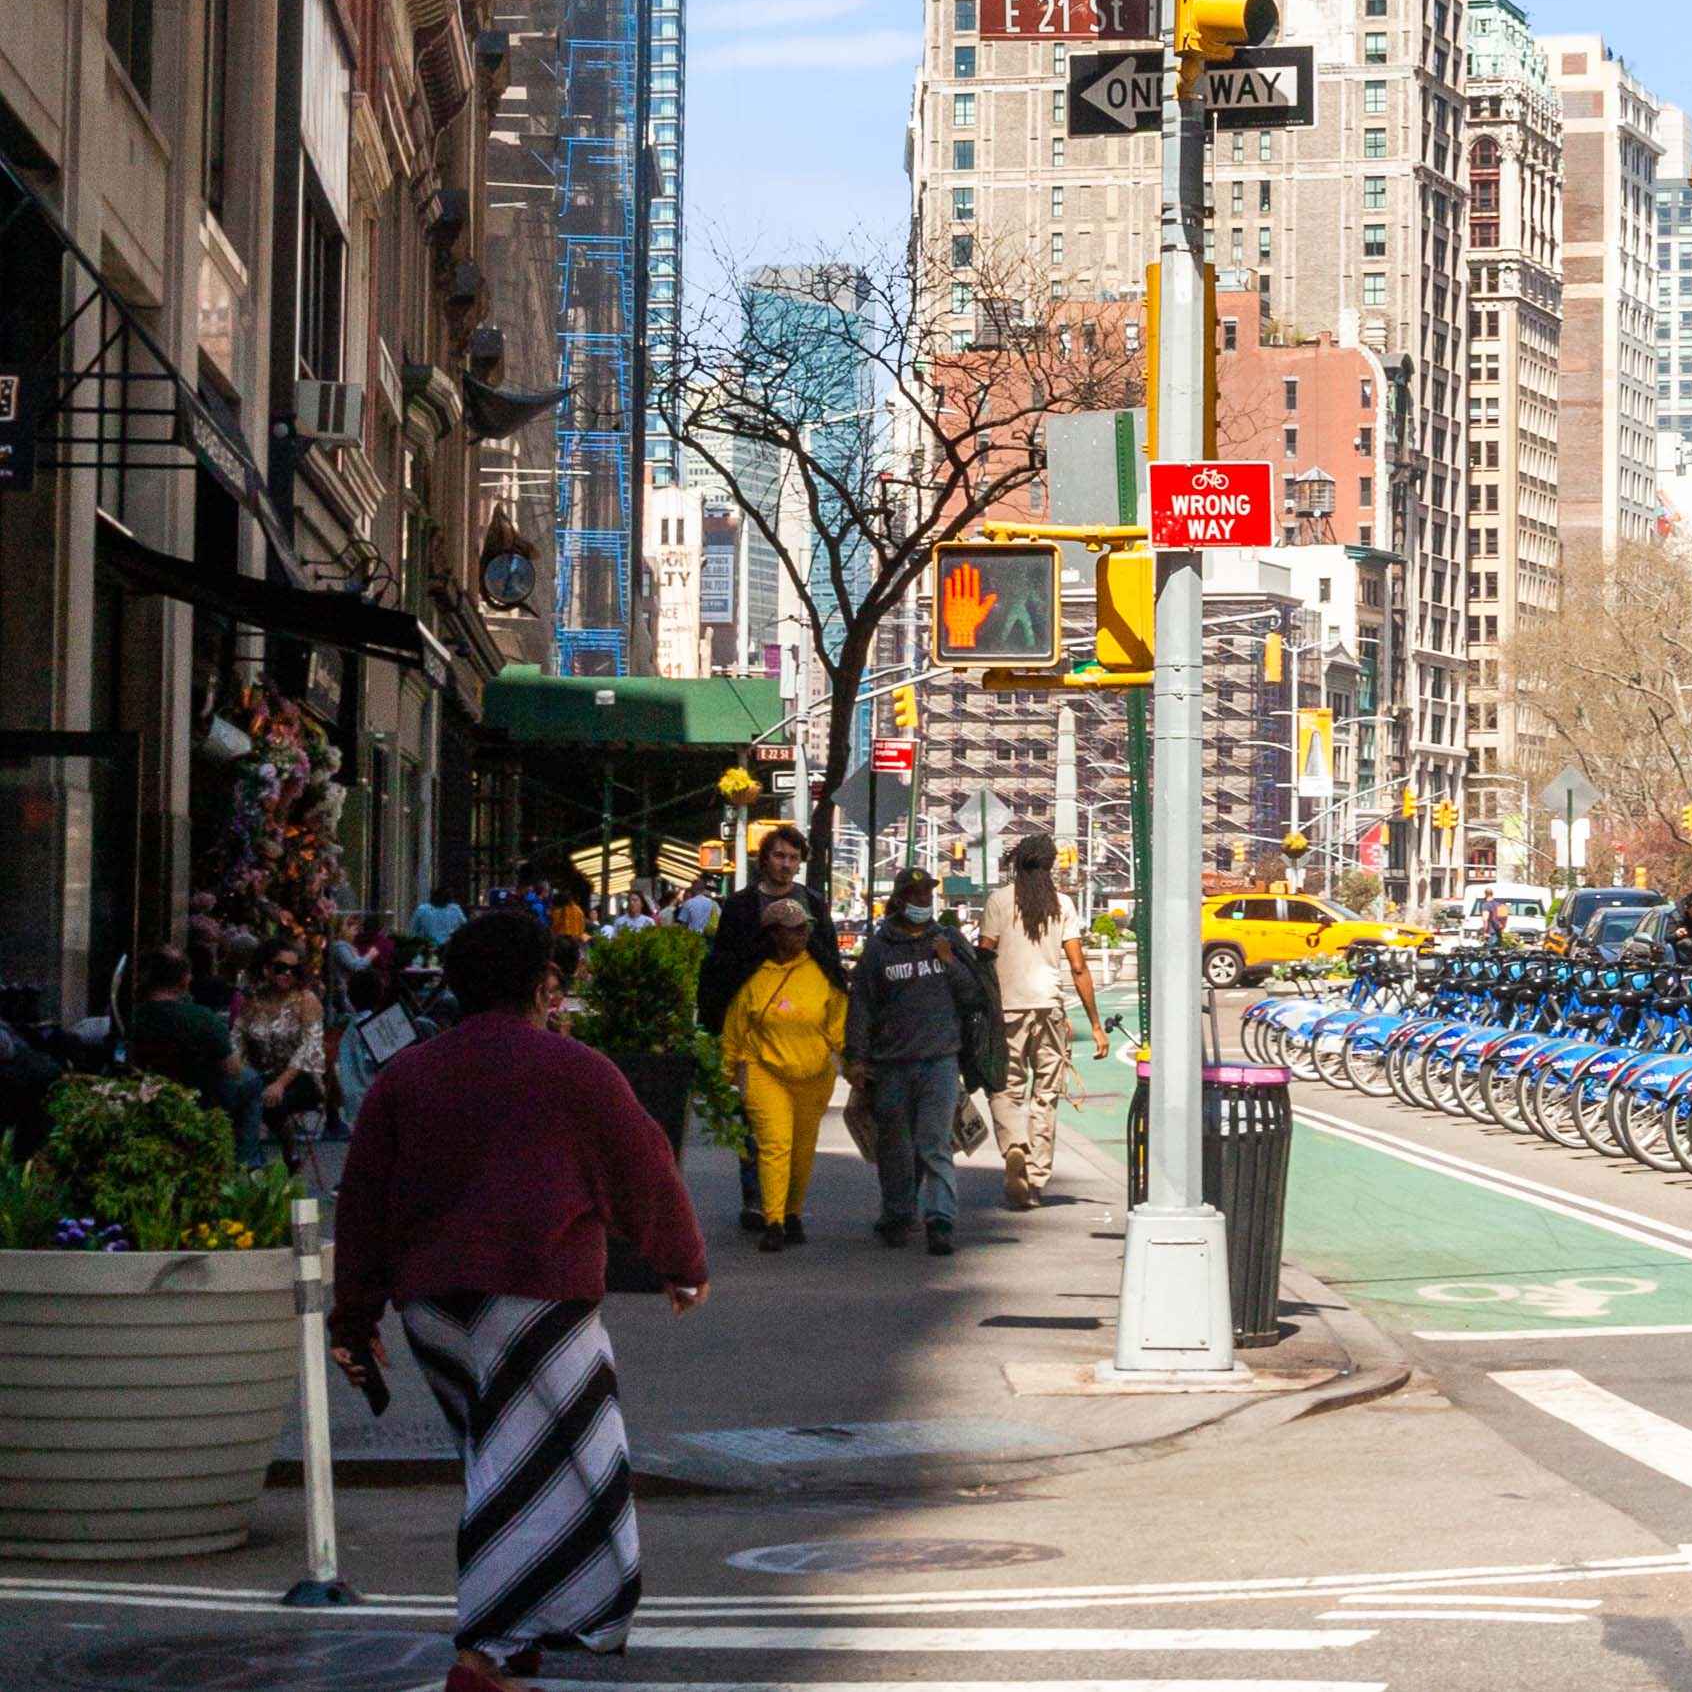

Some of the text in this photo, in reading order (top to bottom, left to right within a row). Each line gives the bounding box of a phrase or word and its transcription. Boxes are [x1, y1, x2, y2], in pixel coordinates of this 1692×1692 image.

[1209, 72, 1282, 105] WAY
[1171, 495, 1251, 516] WRONG
[1187, 519, 1235, 540] WAY
[761, 749, 767, 759] E
[768, 750, 780, 760] 22
